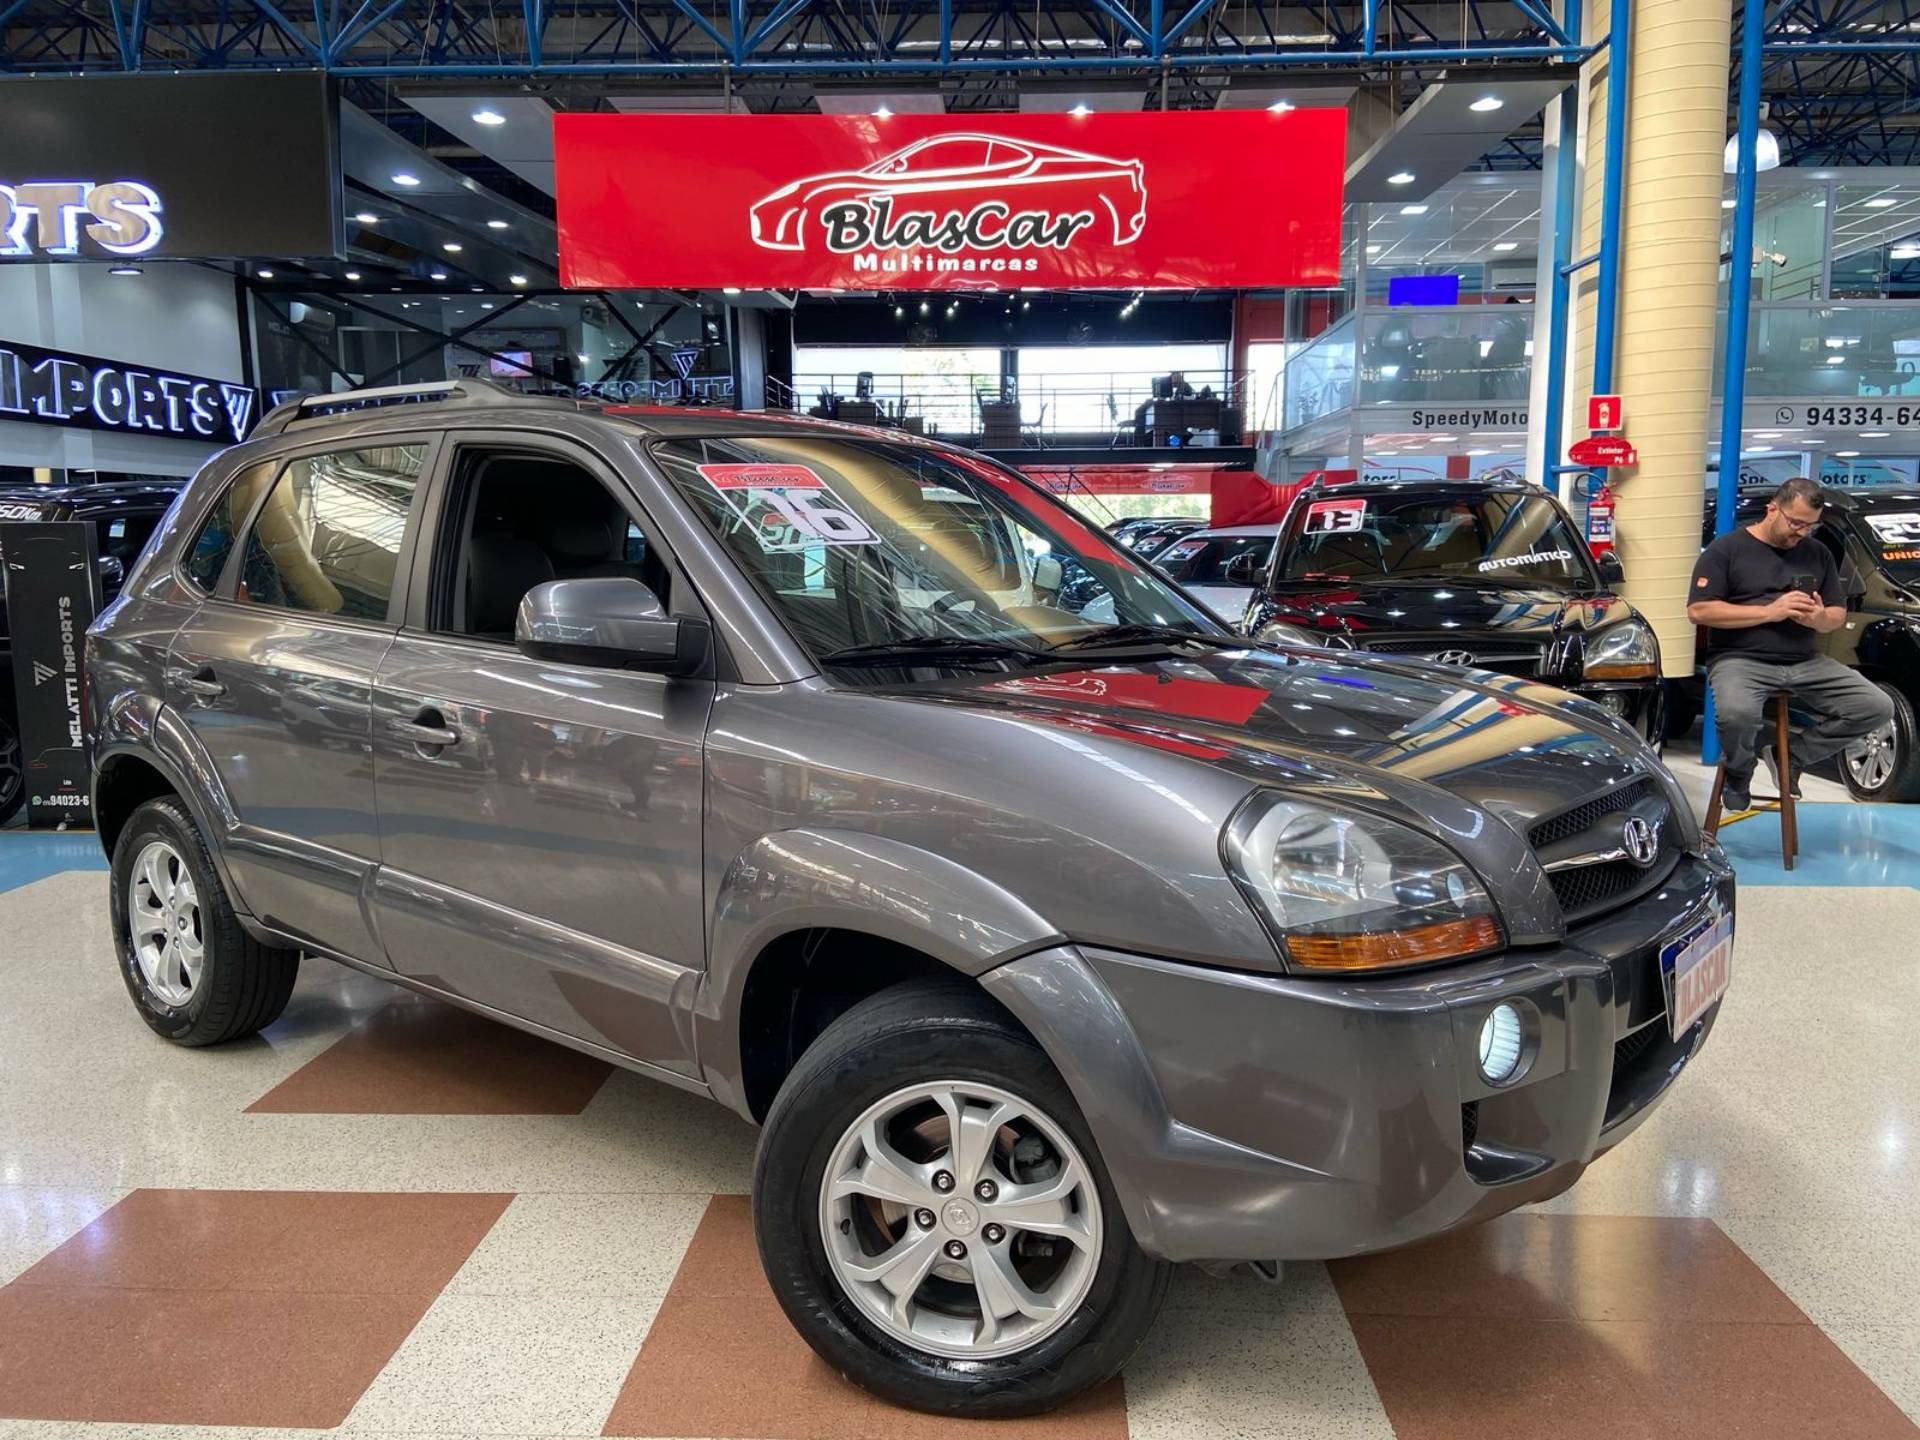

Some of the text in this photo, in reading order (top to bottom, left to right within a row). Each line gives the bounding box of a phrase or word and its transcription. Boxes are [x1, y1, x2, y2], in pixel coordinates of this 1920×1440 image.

[822, 197, 1092, 250] BlasCar
[854, 253, 1038, 272] Multimarcas
[1323, 509, 1361, 530] 13
[58, 596, 83, 748] MELATTI IMPORTS
